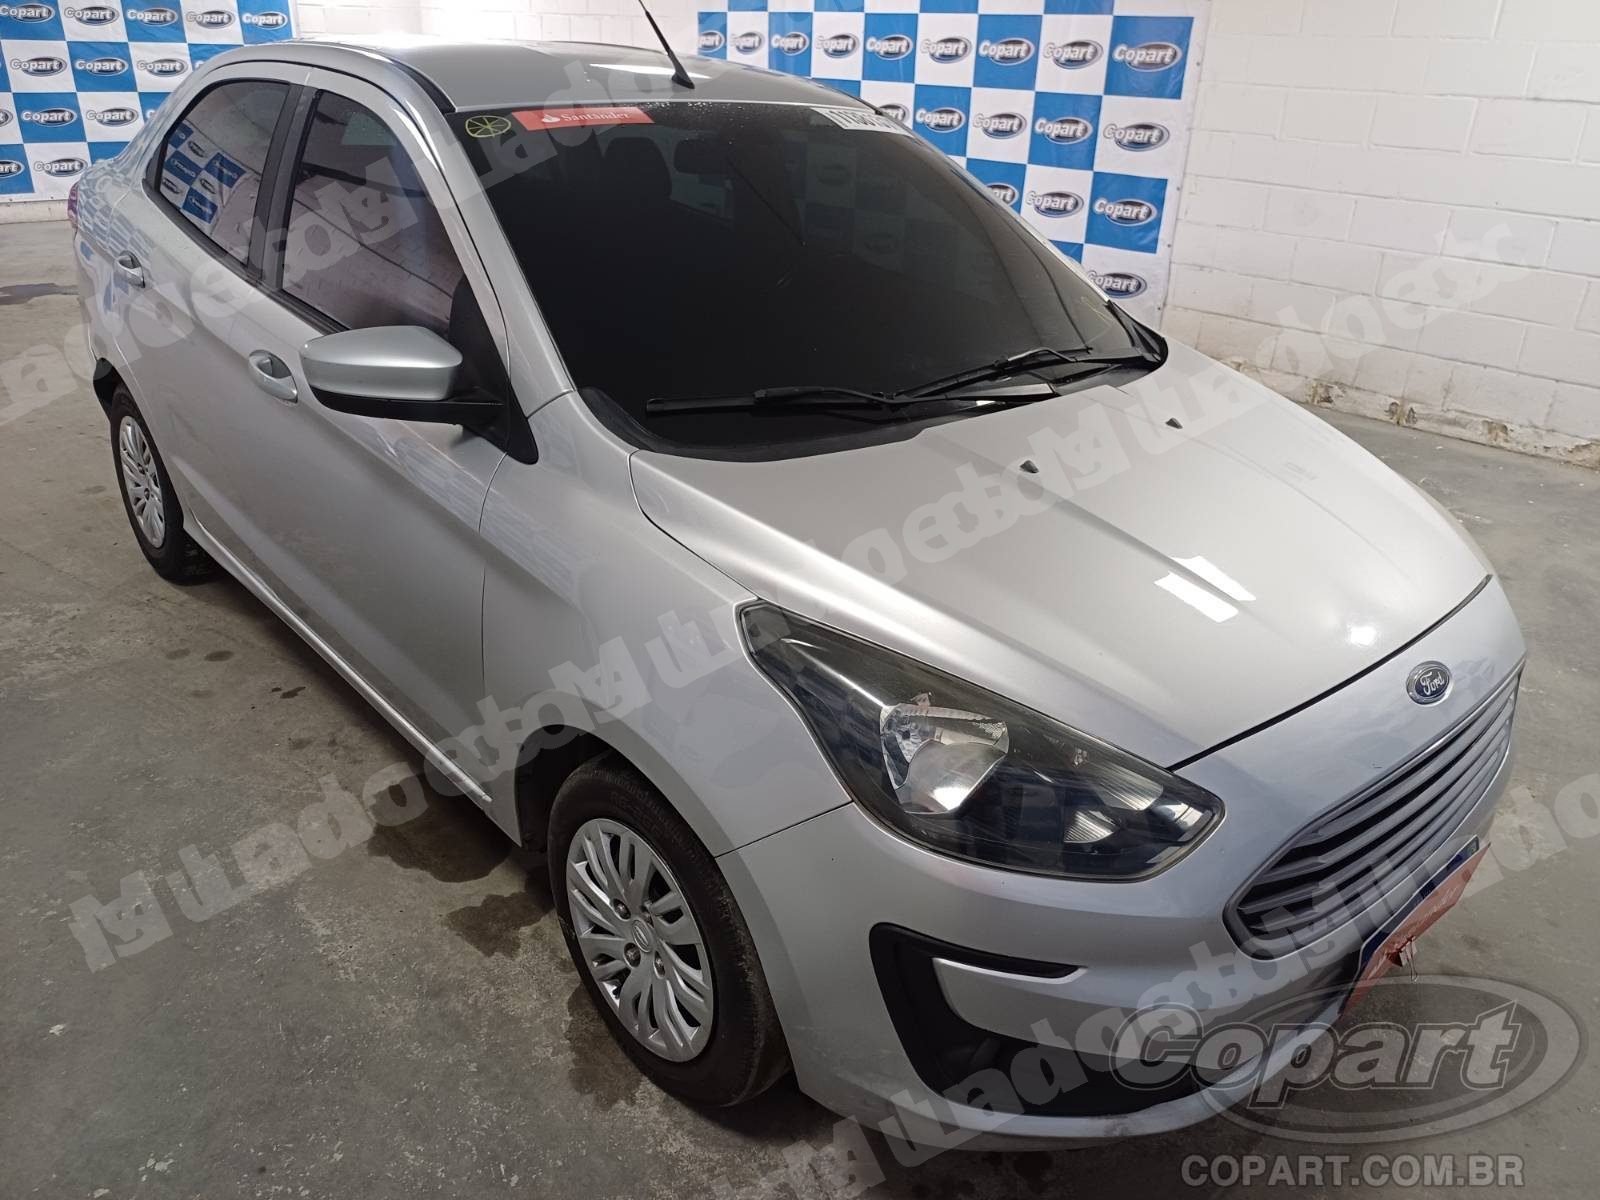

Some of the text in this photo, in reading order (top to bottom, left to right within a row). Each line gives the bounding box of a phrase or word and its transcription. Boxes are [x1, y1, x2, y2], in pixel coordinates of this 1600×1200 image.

[0, 5, 48, 20] Copart
[63, 7, 112, 21] Copart
[127, 8, 171, 24] Copart
[187, 11, 228, 25] Copart
[242, 13, 282, 26] Copart
[771, 34, 804, 51] Copart
[816, 35, 854, 52] Copart
[866, 37, 908, 55] Copart
[920, 39, 965, 58] Copart
[978, 40, 1027, 60] Copart
[1043, 43, 1094, 62] Copart
[1112, 44, 1174, 66] Copart
[10, 58, 60, 73] Copart
[74, 58, 122, 73] Copart
[137, 60, 181, 74] Copart
[21, 110, 70, 123] Copart
[86, 110, 132, 122] Copart
[561, 112, 632, 121] Santander
[915, 108, 961, 128] Copart
[973, 113, 1019, 133] Copart
[1034, 118, 1086, 139] Copart
[1103, 124, 1162, 145] Copart
[33, 160, 80, 174] Copart
[1026, 191, 1075, 210] Copart
[1093, 198, 1148, 220] Copart
[1419, 671, 1445, 696] Ford
